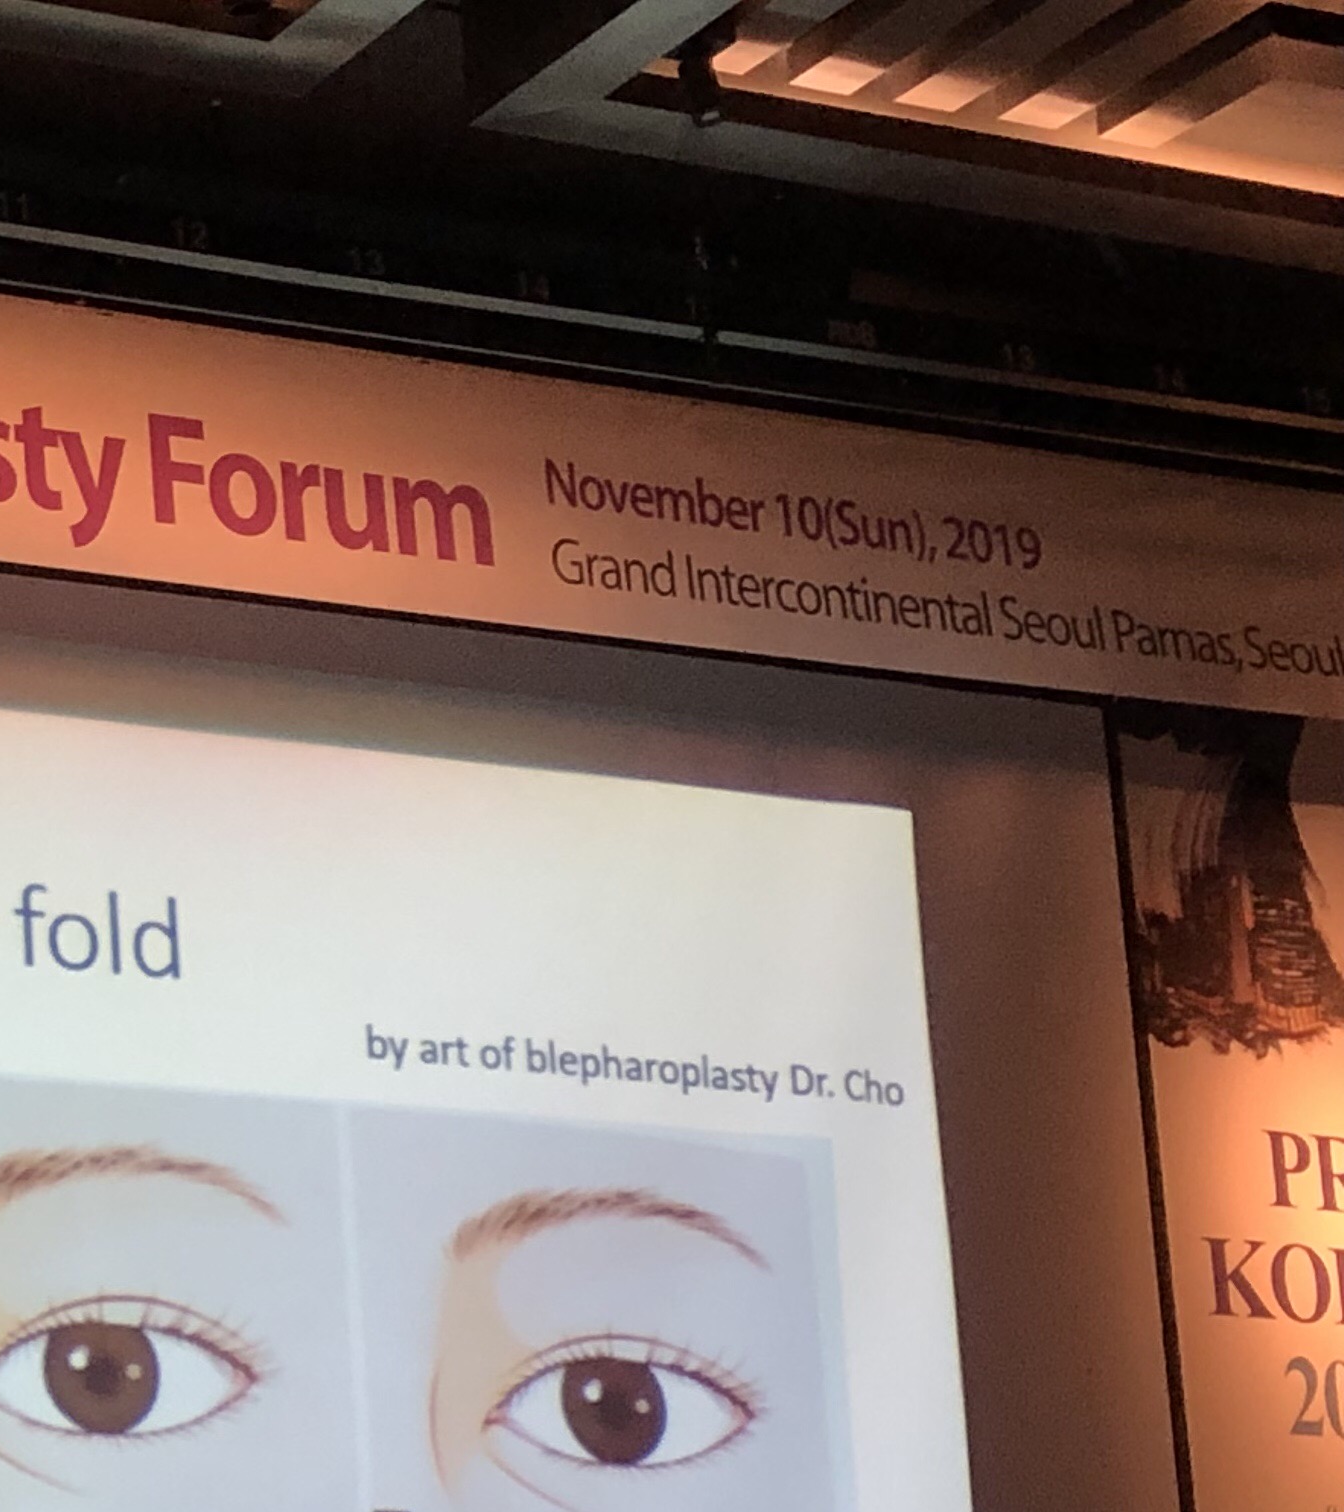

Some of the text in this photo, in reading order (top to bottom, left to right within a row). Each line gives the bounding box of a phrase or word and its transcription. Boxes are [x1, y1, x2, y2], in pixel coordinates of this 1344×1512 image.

[148, 412, 495, 568] Forum
[544, 458, 1042, 570] November 10(Sun), 2019
[552, 538, 677, 598] Grand
[686, 554, 994, 637] Intercontinental
[1000, 595, 1106, 651] Seoul
[16, 882, 183, 981] fold
[365, 1023, 905, 1106] by art of blepharoplasty Dr. Cho
